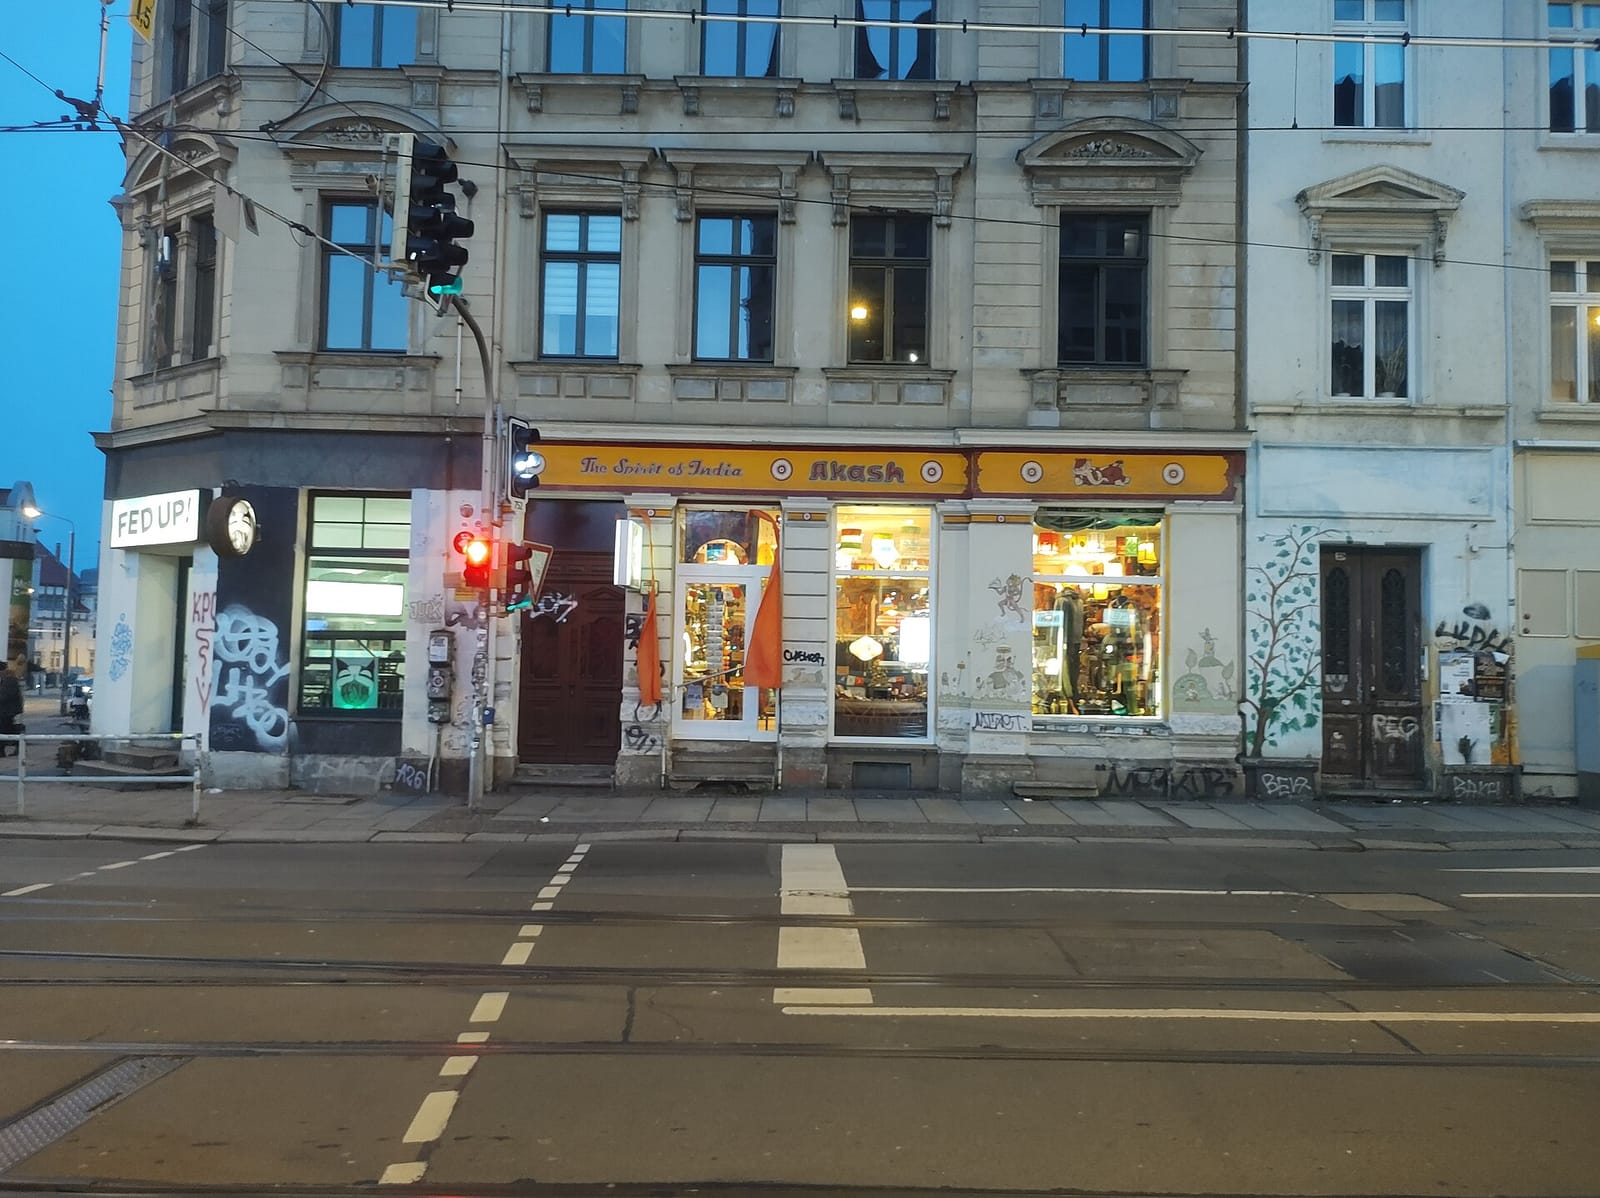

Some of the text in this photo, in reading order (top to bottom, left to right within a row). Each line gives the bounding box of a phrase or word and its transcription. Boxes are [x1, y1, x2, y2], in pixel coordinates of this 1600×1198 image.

[580, 456, 744, 477] The Spirit of India
[808, 460, 905, 483] Akash
[118, 497, 192, 538] FED UP!
